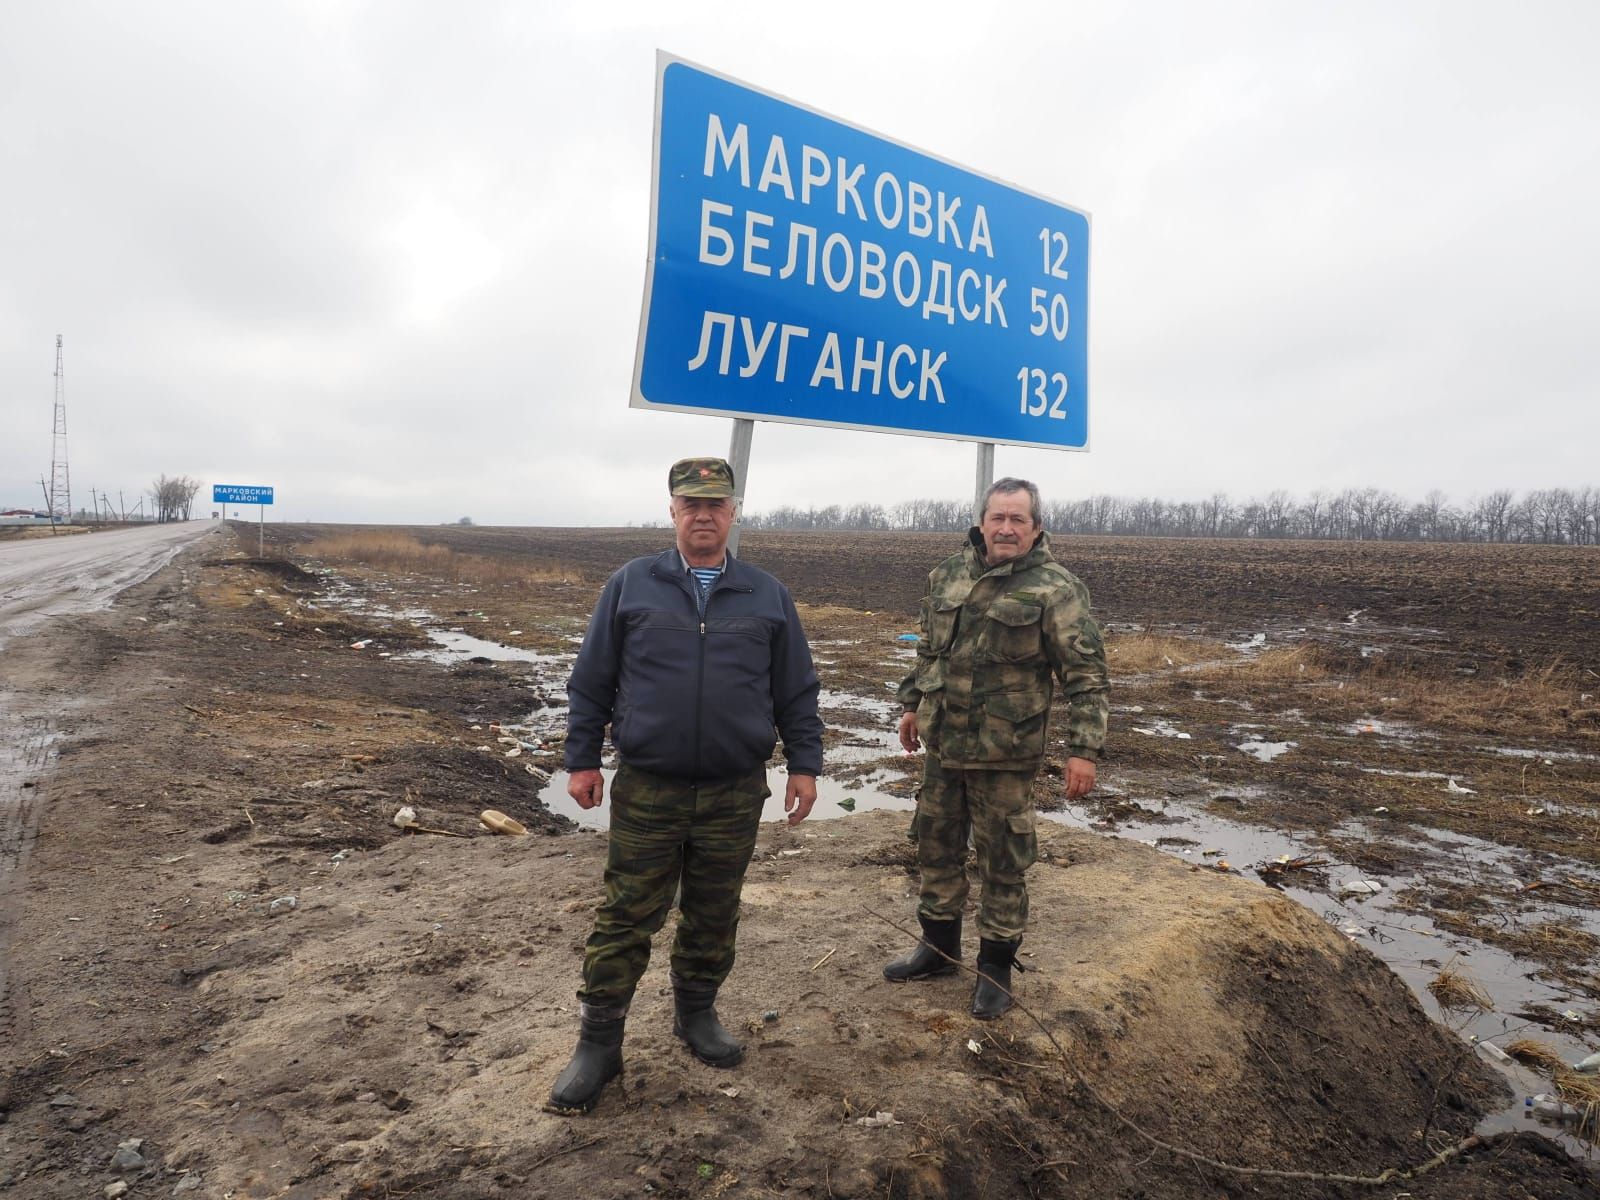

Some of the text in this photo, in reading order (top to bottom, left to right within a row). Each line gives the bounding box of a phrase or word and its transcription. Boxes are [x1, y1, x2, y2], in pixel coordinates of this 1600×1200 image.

[703, 113, 1069, 280] МАРКОВКА 12
[699, 199, 1069, 342] БЕЛОВОДСК 50
[688, 310, 1068, 420] ЛУГАНСК 132
[214, 487, 273, 496] МАРКОВСКИЙ
[229, 494, 258, 502] РАЙОН
